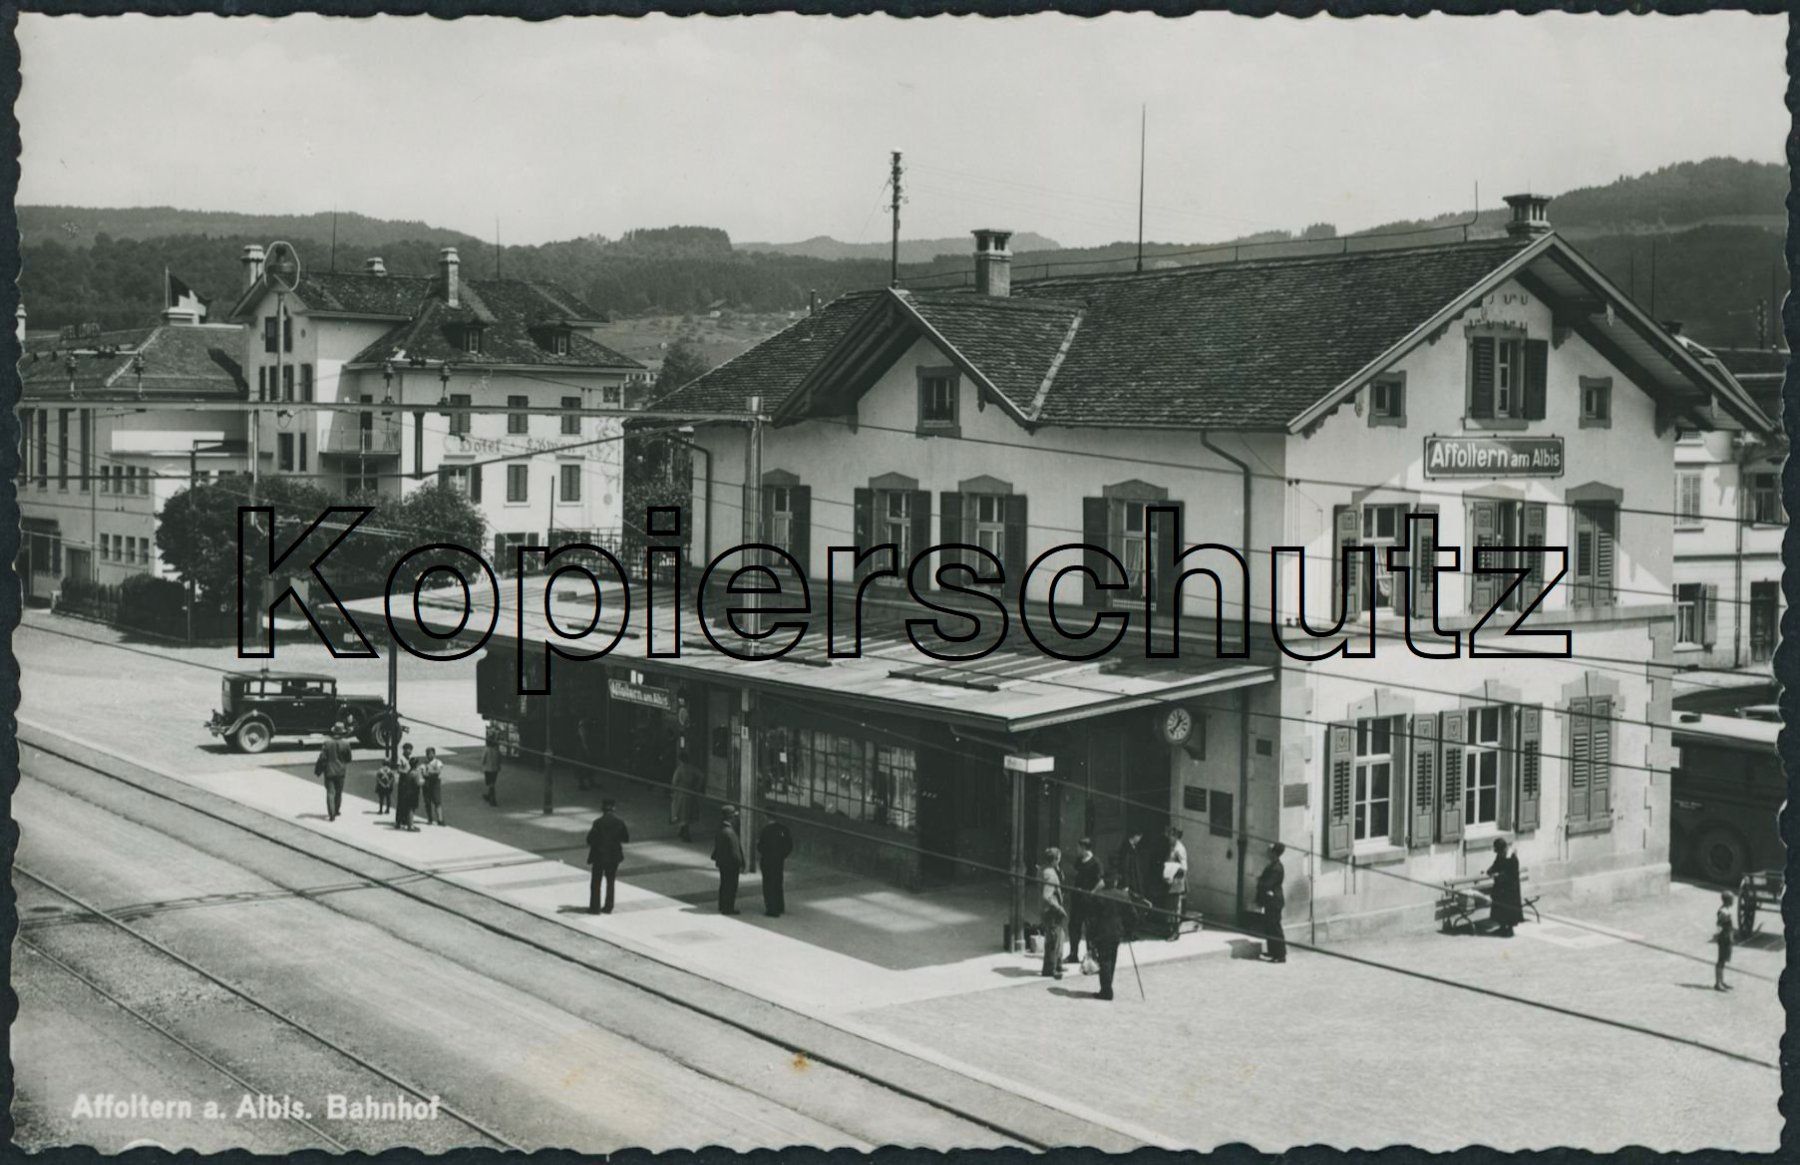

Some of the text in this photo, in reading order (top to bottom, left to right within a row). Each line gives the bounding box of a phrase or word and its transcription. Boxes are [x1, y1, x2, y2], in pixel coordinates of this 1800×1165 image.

[1430, 442, 1560, 468] Affoltern am Albis
